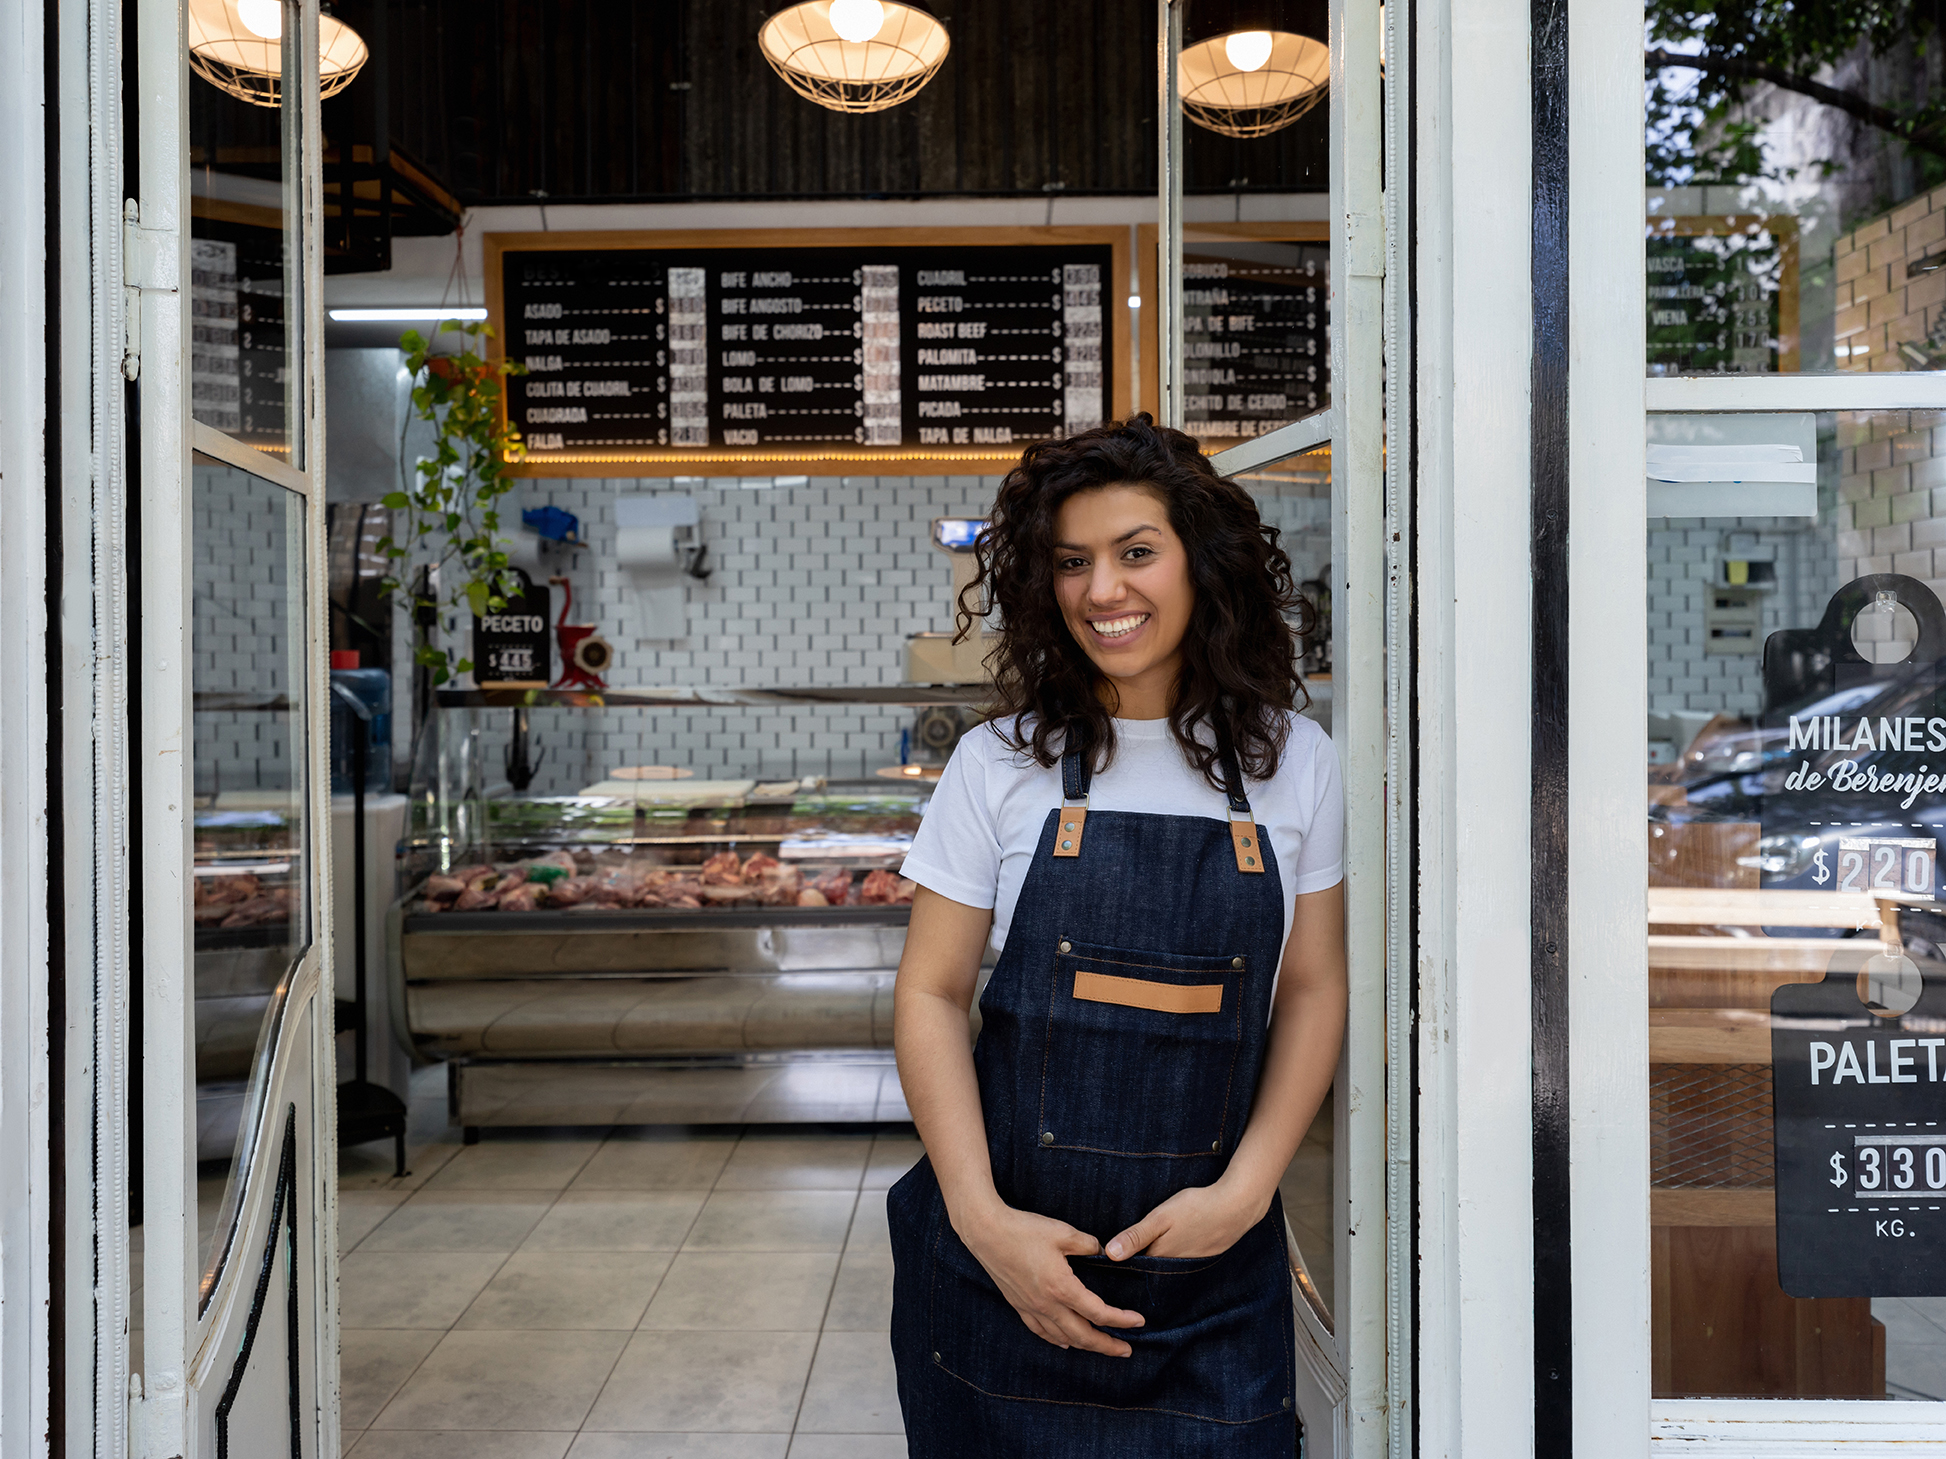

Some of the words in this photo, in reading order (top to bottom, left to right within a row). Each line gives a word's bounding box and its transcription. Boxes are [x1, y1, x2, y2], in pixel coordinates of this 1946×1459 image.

[721, 271, 747, 288] BIFE
[752, 271, 792, 288] ANCHO
[917, 270, 967, 286] CUADRIL
[525, 303, 562, 319] ASADO
[721, 298, 747, 314] BIFE
[749, 297, 803, 314] ANGOSTO
[917, 296, 963, 312] PECETO
[1183, 315, 1203, 332] APA
[1208, 315, 1224, 331] DE
[1228, 315, 1255, 332] BIFE
[1652, 309, 1688, 326] VIENA
[1736, 309, 1769, 328] 255
[525, 329, 553, 345] TAPA
[555, 329, 570, 345] DE
[573, 328, 611, 345] ASADO
[722, 324, 747, 340] BIFE
[753, 324, 769, 340] DE
[773, 323, 823, 340] CHORIZO
[917, 322, 955, 339] ROAST
[957, 322, 988, 339] BEEF
[722, 350, 756, 367] LOMO
[917, 348, 977, 365] PALOMITA
[1184, 342, 1241, 358] OLOMILLO
[525, 355, 563, 371] NALGA
[722, 376, 753, 393] BOLA
[759, 376, 775, 393] DE
[781, 376, 814, 393] LOMO
[918, 374, 985, 391] MATAMBRE
[1184, 368, 1236, 385] ONDIOLA
[526, 381, 565, 397] COLITA
[566, 381, 582, 397] DE
[583, 380, 632, 397] CUADRIL
[723, 402, 767, 419] PALETA
[918, 401, 961, 417] PICADA
[1184, 394, 1223, 411] ECHITO
[1227, 394, 1243, 411] DE
[1247, 394, 1287, 411] CERDO
[527, 407, 588, 423] CUADRADA
[918, 427, 949, 444] TAPA
[952, 427, 969, 444] DE
[973, 427, 1012, 444] NALGA
[1240, 420, 1258, 437] DE
[527, 433, 564, 449] FALDA
[481, 615, 544, 633] PECETO
[500, 652, 532, 668] 445
[1789, 716, 1946, 752] MILANES
[1784, 760, 1826, 791] de
[1812, 848, 1830, 885] $
[1841, 846, 1931, 893] 220
[1809, 1038, 1946, 1085] PALET
[1829, 1151, 1848, 1189] $
[1859, 1147, 1946, 1190] 330
[1876, 1219, 1916, 1238] KG.
